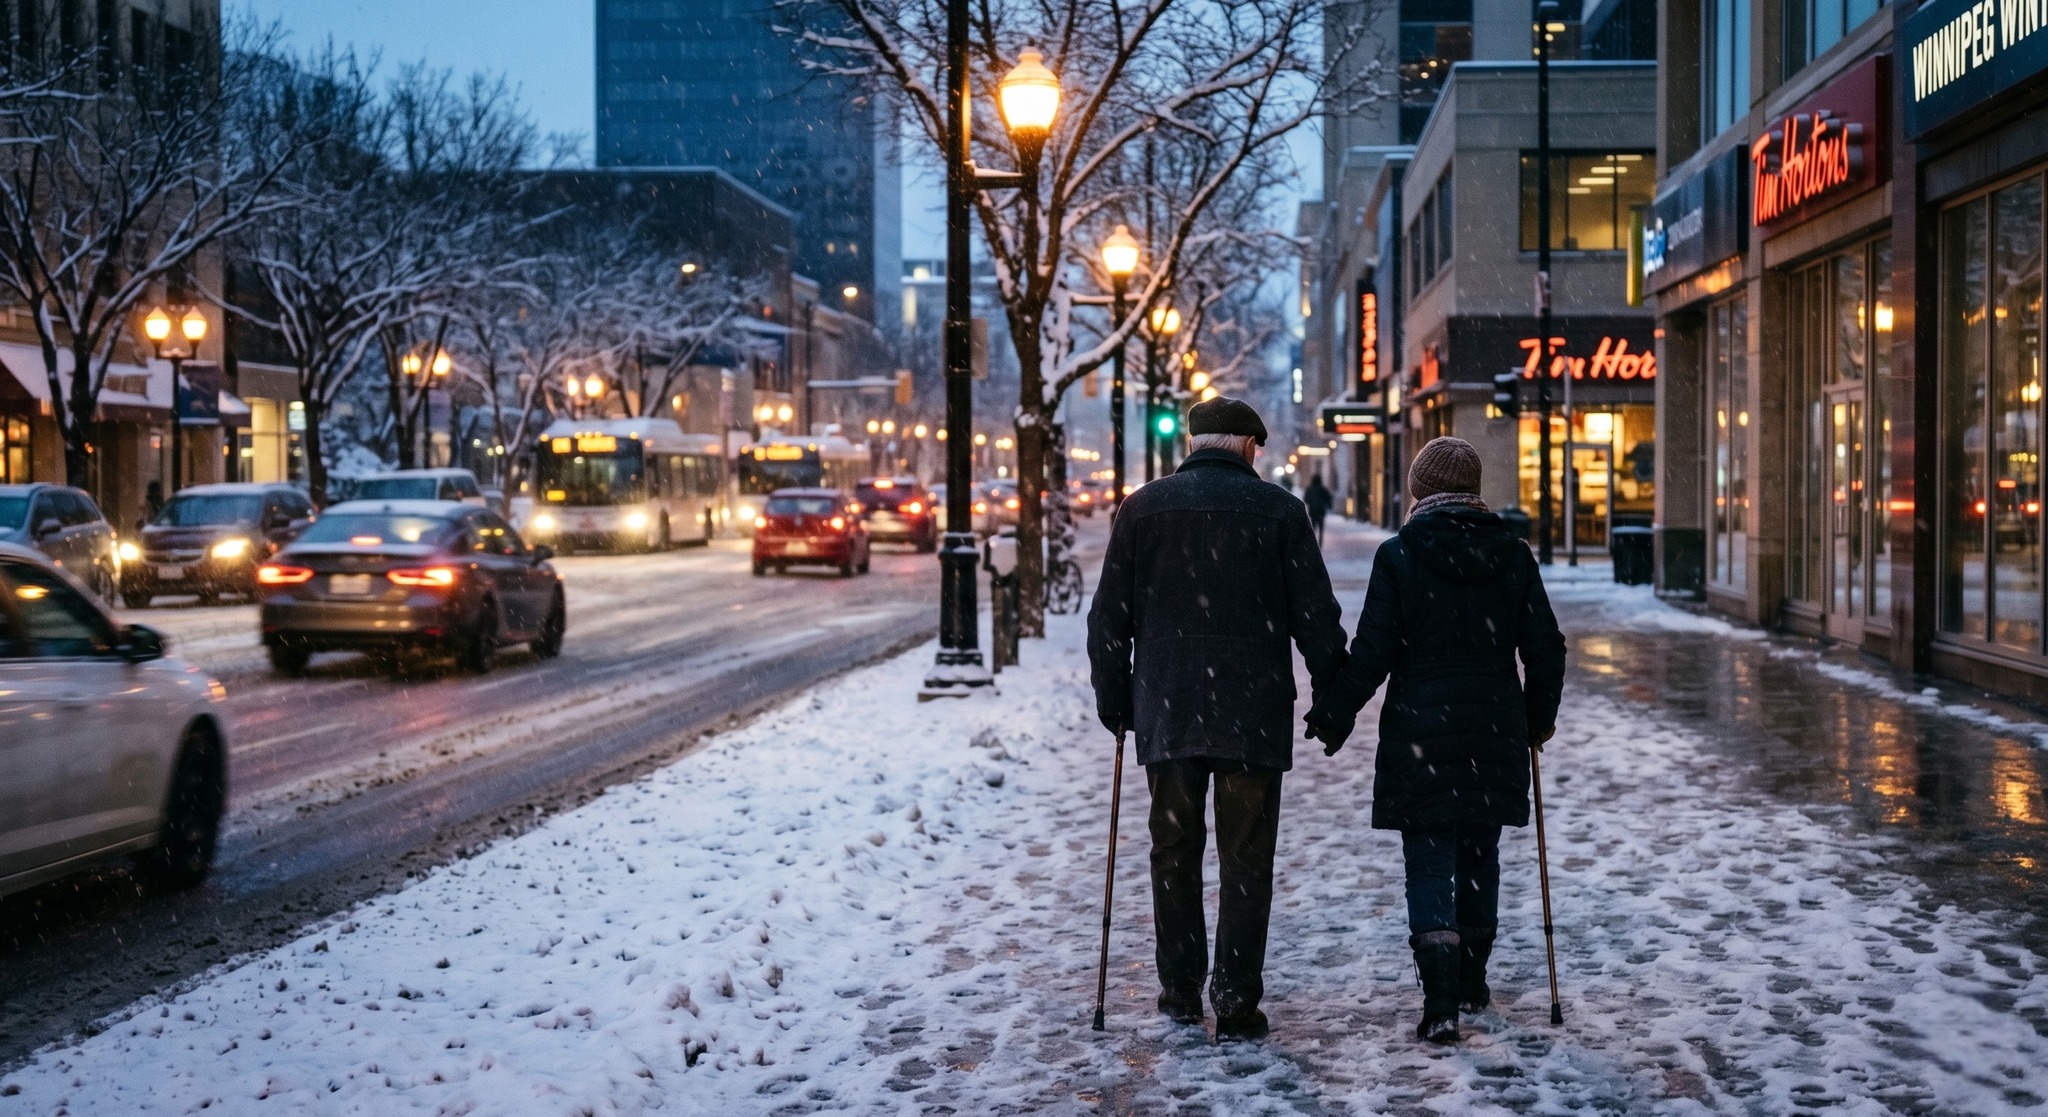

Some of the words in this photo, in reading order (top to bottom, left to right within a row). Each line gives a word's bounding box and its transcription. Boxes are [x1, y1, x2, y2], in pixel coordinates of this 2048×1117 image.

[1913, 0, 1995, 103] WINNIPEG
[1752, 132, 1779, 227] Tim
[1781, 112, 1849, 212] Hortons
